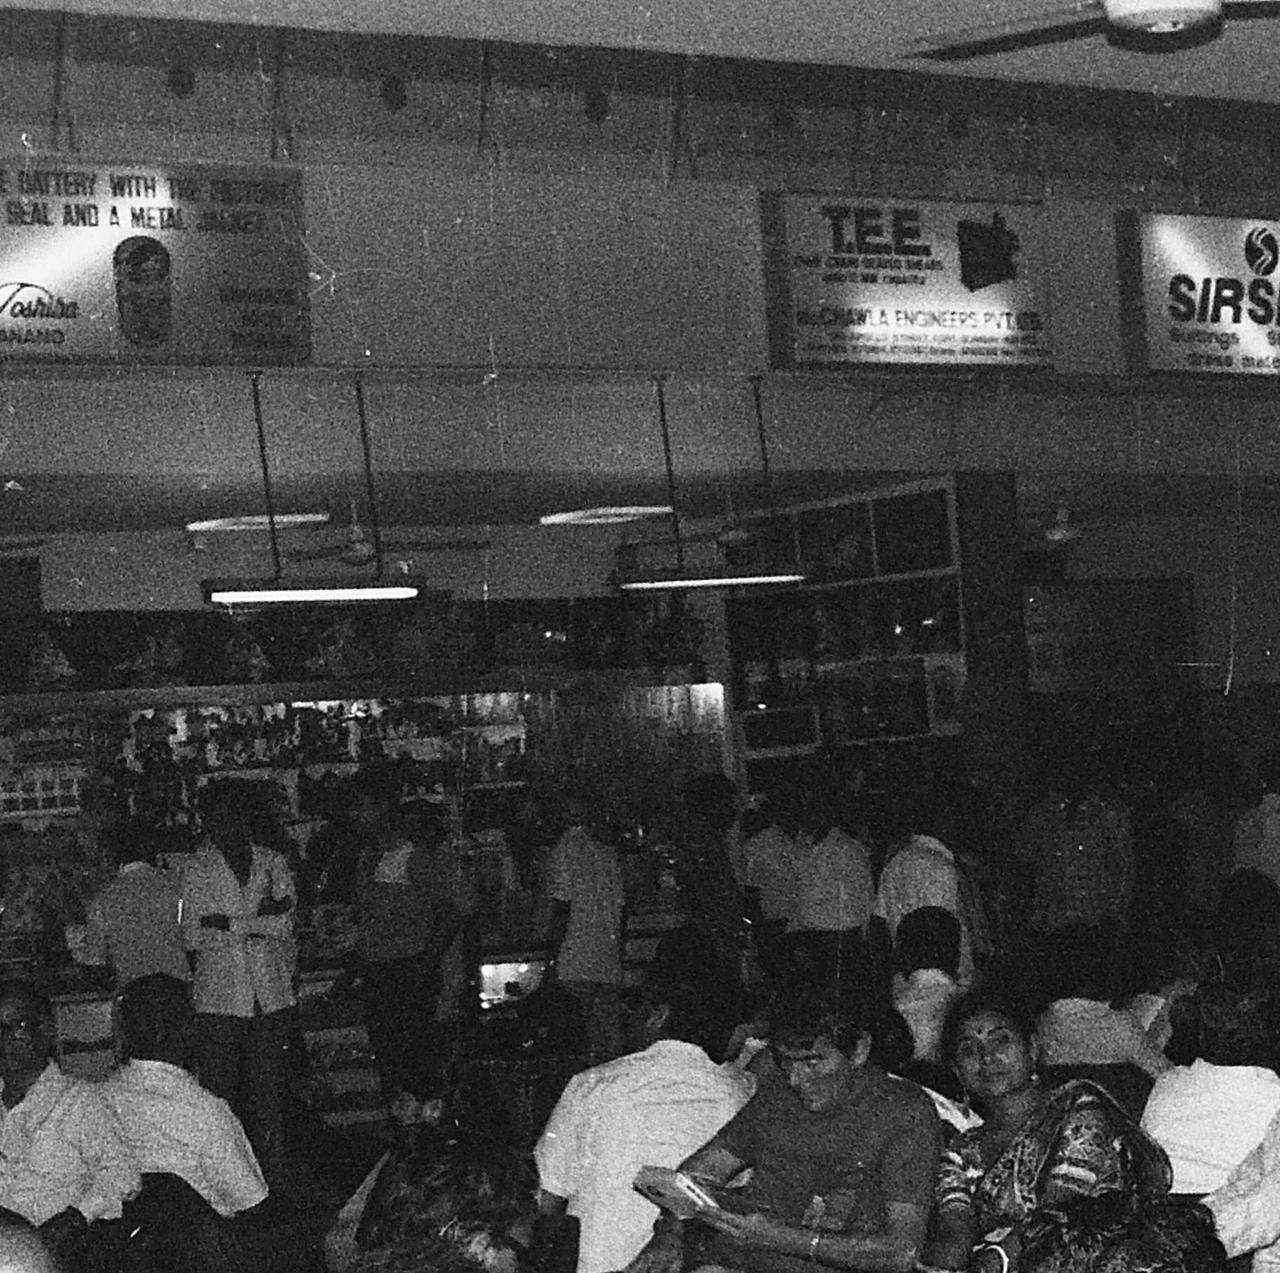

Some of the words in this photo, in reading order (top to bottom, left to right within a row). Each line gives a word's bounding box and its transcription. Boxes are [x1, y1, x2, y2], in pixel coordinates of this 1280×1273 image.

[109, 173, 155, 199] WITH
[62, 203, 99, 227] AND
[108, 204, 121, 226] A
[130, 206, 187, 230] METAL
[821, 205, 932, 256] TEE
